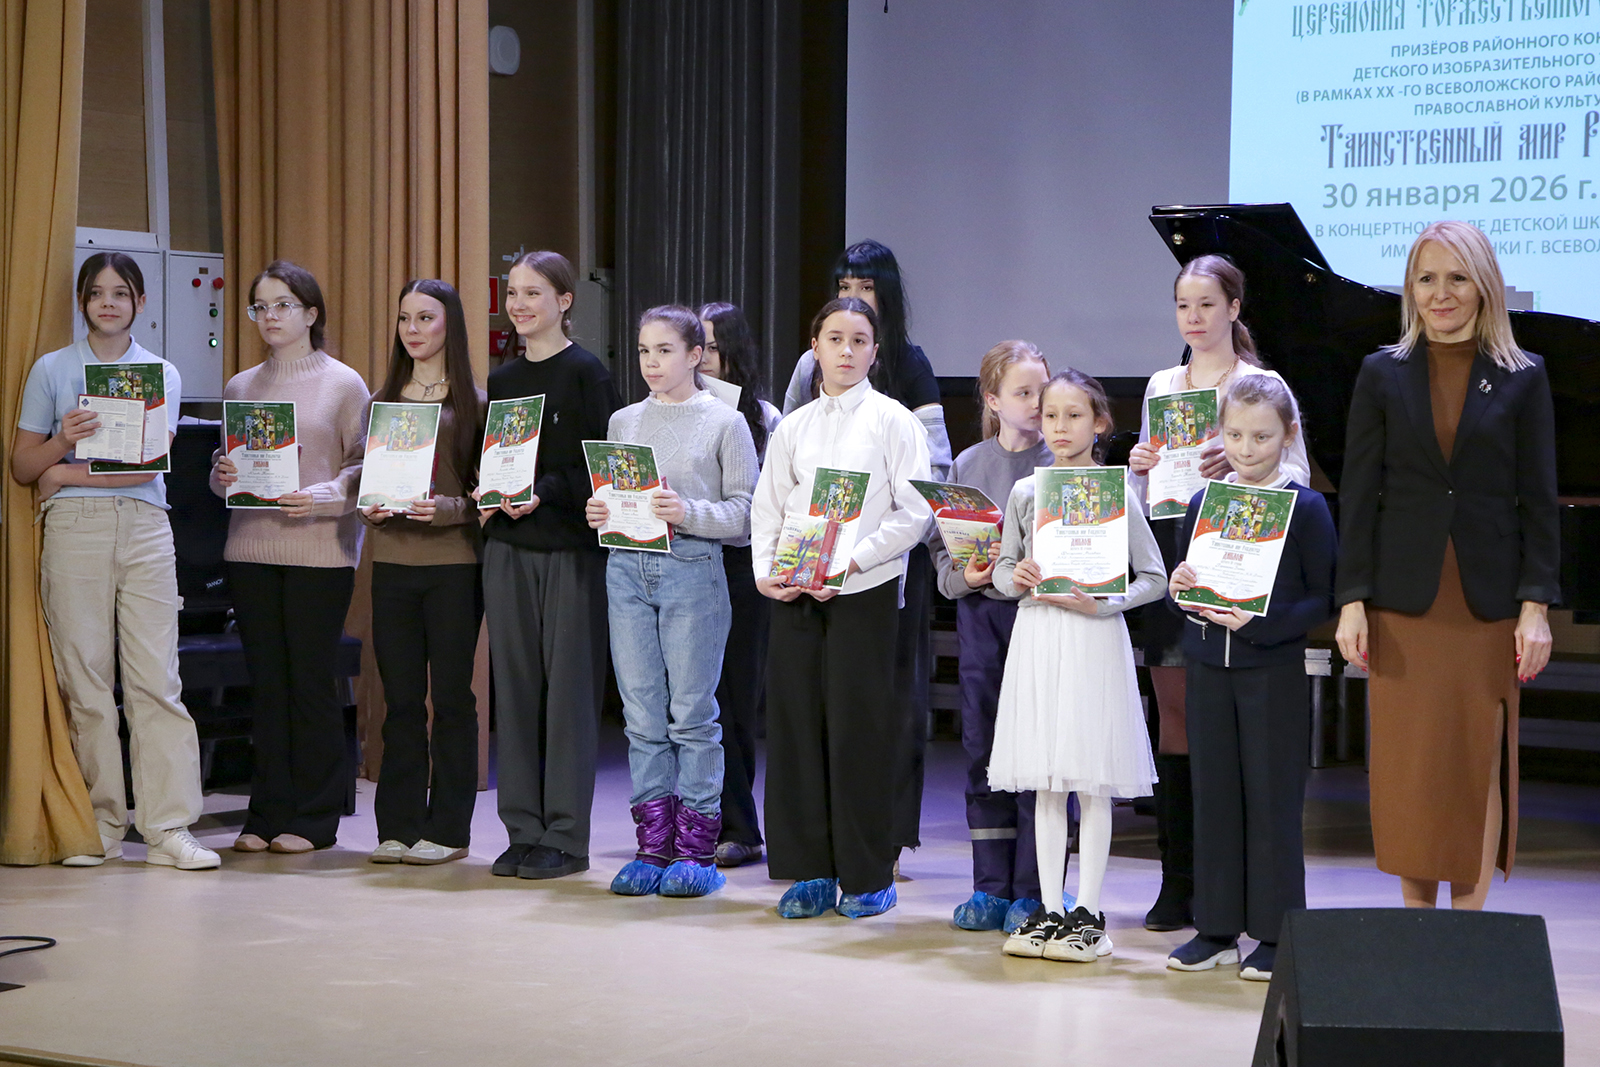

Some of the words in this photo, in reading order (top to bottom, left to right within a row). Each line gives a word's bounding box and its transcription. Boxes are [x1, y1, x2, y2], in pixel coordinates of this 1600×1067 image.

[1391, 40, 1469, 57] ПРИЗЁРОВ
[1473, 34, 1569, 52] РАЙОННОГО
[1353, 63, 1429, 82] ДЕТСКОГО
[1432, 53, 1596, 75] ИЗОБРАЗИТЕЛЬНОГО
[1296, 90, 1309, 105] (В
[1313, 86, 1373, 102] РАМКАХ
[1426, 76, 1561, 96] ВСЕВОЛОЖСКОГО
[1414, 95, 1540, 116] ПРАВОСЛАВНОЙ
[1322, 182, 1358, 209] 30
[1366, 184, 1479, 211] января
[1490, 174, 1568, 203] 2026
[1579, 179, 1597, 200] г.
[1315, 224, 1324, 237] В
[1490, 213, 1568, 235] ДЕТСКОЙ
[1526, 240, 1536, 254] Г.
